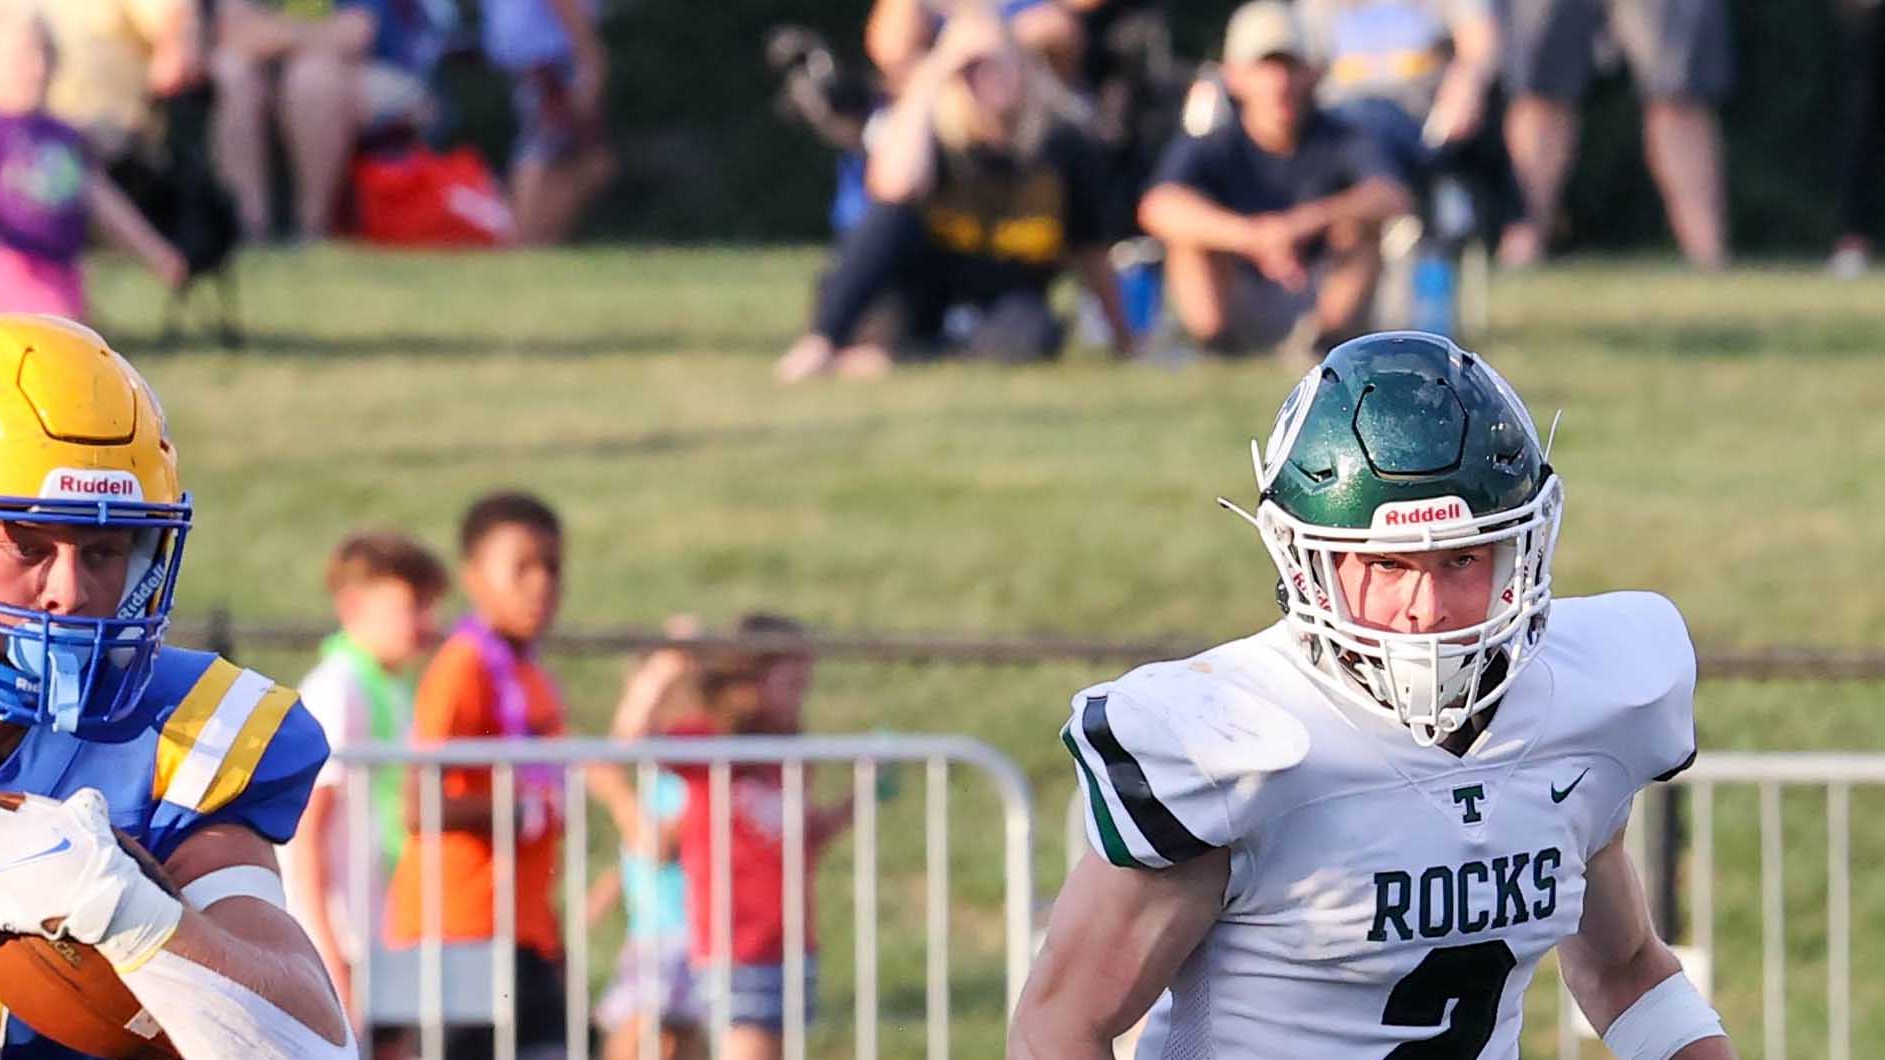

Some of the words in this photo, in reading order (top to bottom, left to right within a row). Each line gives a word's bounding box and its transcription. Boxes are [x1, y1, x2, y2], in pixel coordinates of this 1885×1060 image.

[60, 475, 133, 495] Riddell
[1385, 503, 1461, 526] Riddell
[1452, 783, 1485, 824] T
[1367, 846, 1561, 943] ROCKS
